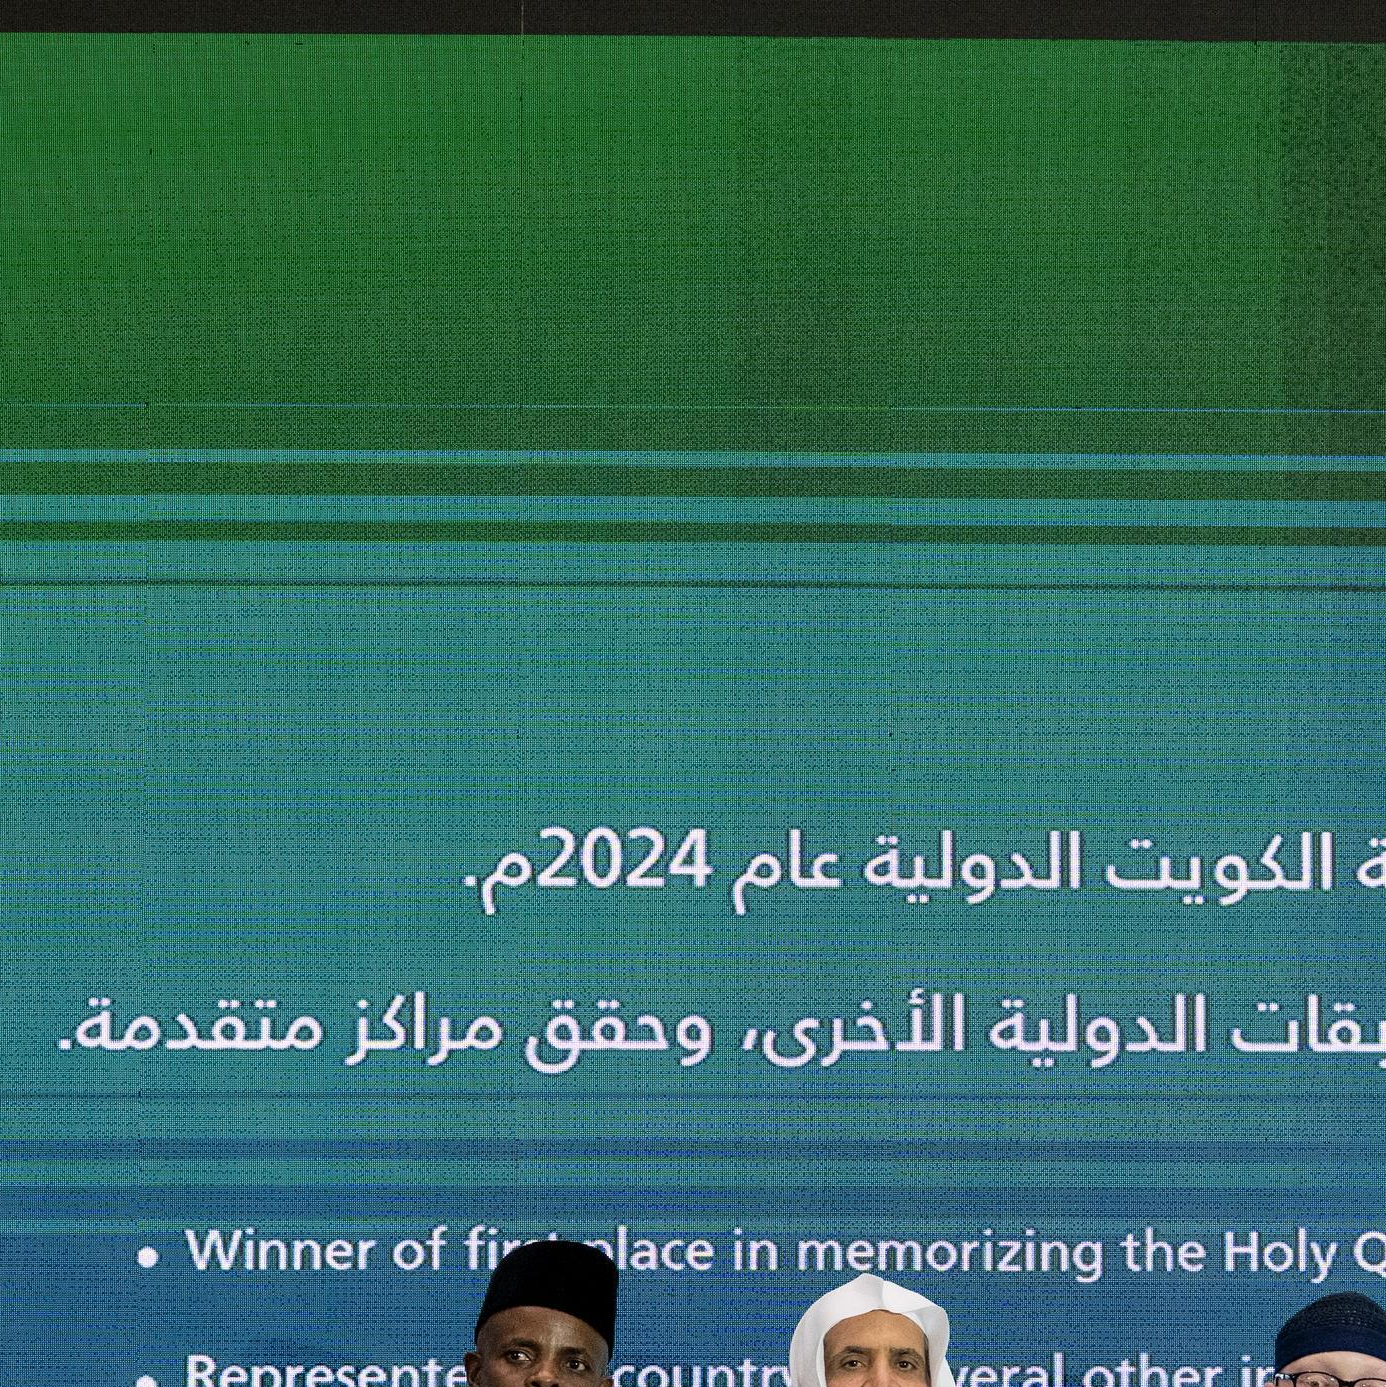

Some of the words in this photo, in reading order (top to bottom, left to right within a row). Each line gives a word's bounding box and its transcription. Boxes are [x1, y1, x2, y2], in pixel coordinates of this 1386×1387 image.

[732, 828, 841, 915] عام
[864, 830, 1081, 905] الدولية
[1106, 831, 1333, 906] الكويت
[59, 996, 323, 1052] متقدمة.
[345, 990, 503, 1066] مراكز
[525, 998, 712, 1075] وحقق
[989, 993, 1206, 1069] الدولية
[185, 1228, 375, 1271] Winner
[392, 1225, 447, 1271] of
[463, 1224, 559, 1271] fir
[583, 1225, 714, 1271] lace
[733, 1230, 778, 1270] in
[798, 1228, 1103, 1284] memorizing
[1121, 1228, 1206, 1272] the
[1225, 1228, 1338, 1285] Holy
